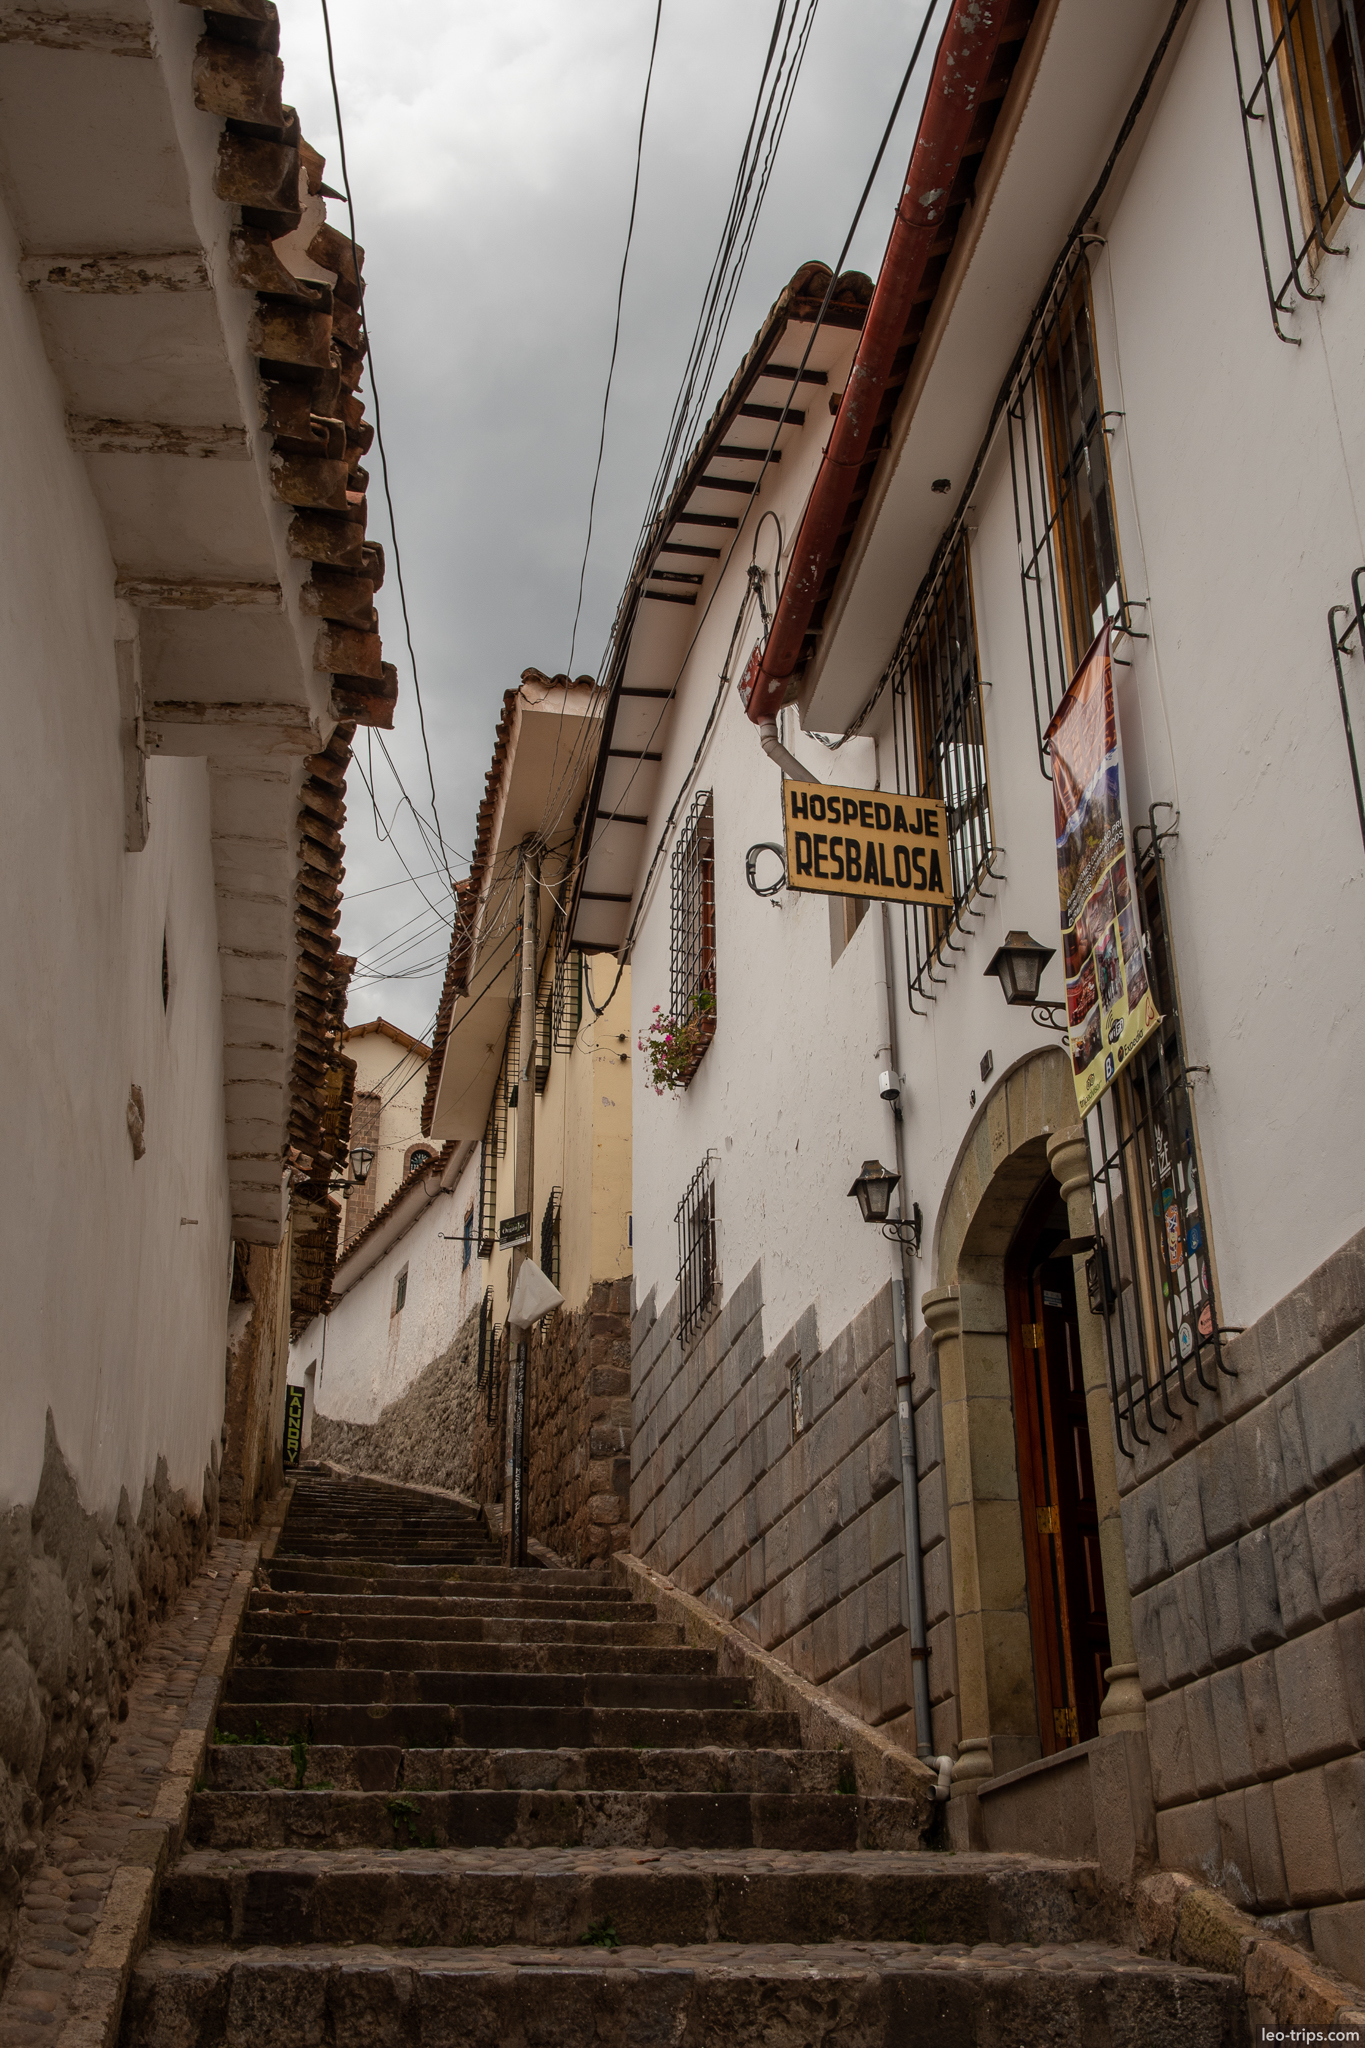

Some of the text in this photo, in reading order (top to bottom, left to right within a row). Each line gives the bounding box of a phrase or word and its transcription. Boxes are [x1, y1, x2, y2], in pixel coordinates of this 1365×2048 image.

[791, 790, 939, 838] HOSPEDAJE
[794, 831, 944, 893] RESBALOSA
[1123, 1028, 1144, 1057] Expedia
[286, 1385, 302, 1463] LAUNDRY
